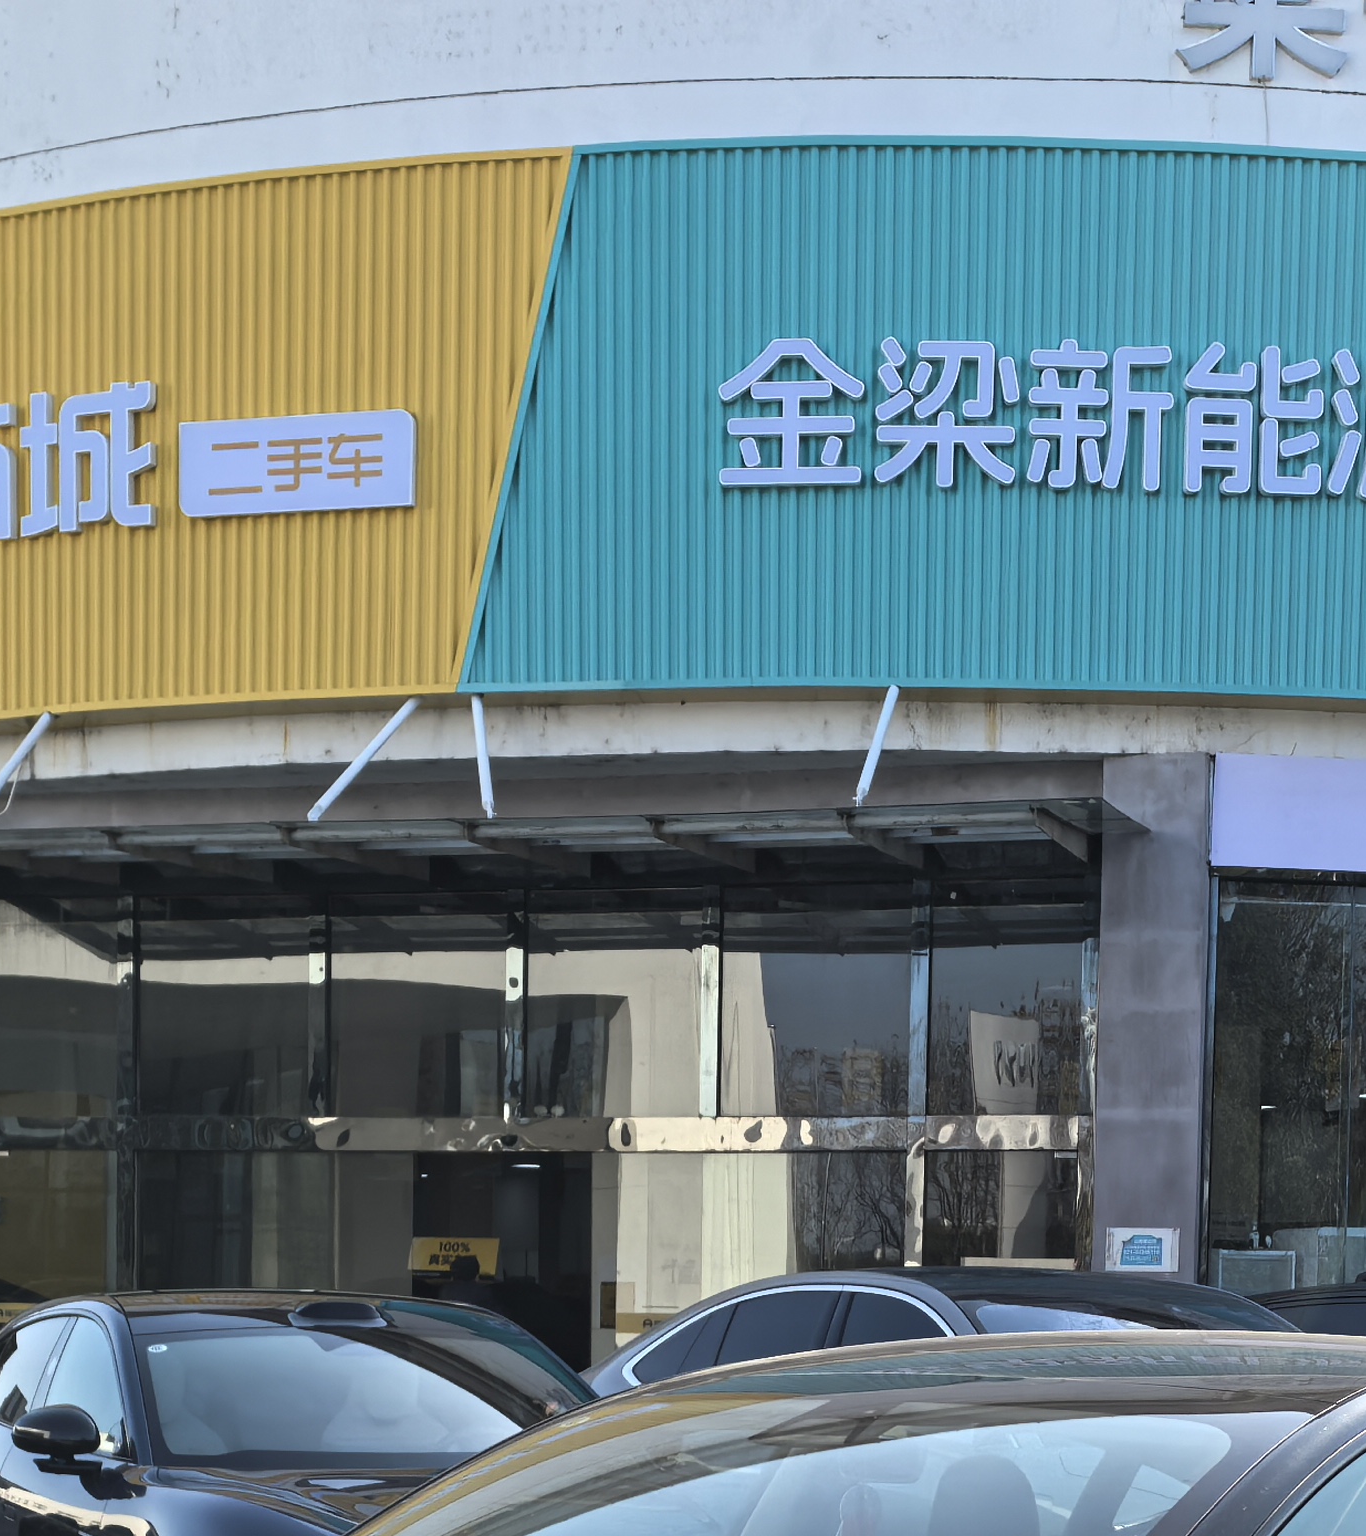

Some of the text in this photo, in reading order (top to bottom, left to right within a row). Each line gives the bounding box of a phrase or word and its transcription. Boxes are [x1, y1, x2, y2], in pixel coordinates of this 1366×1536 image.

[208, 433, 383, 496] 二手车
[439, 1241, 471, 1253] 100%
